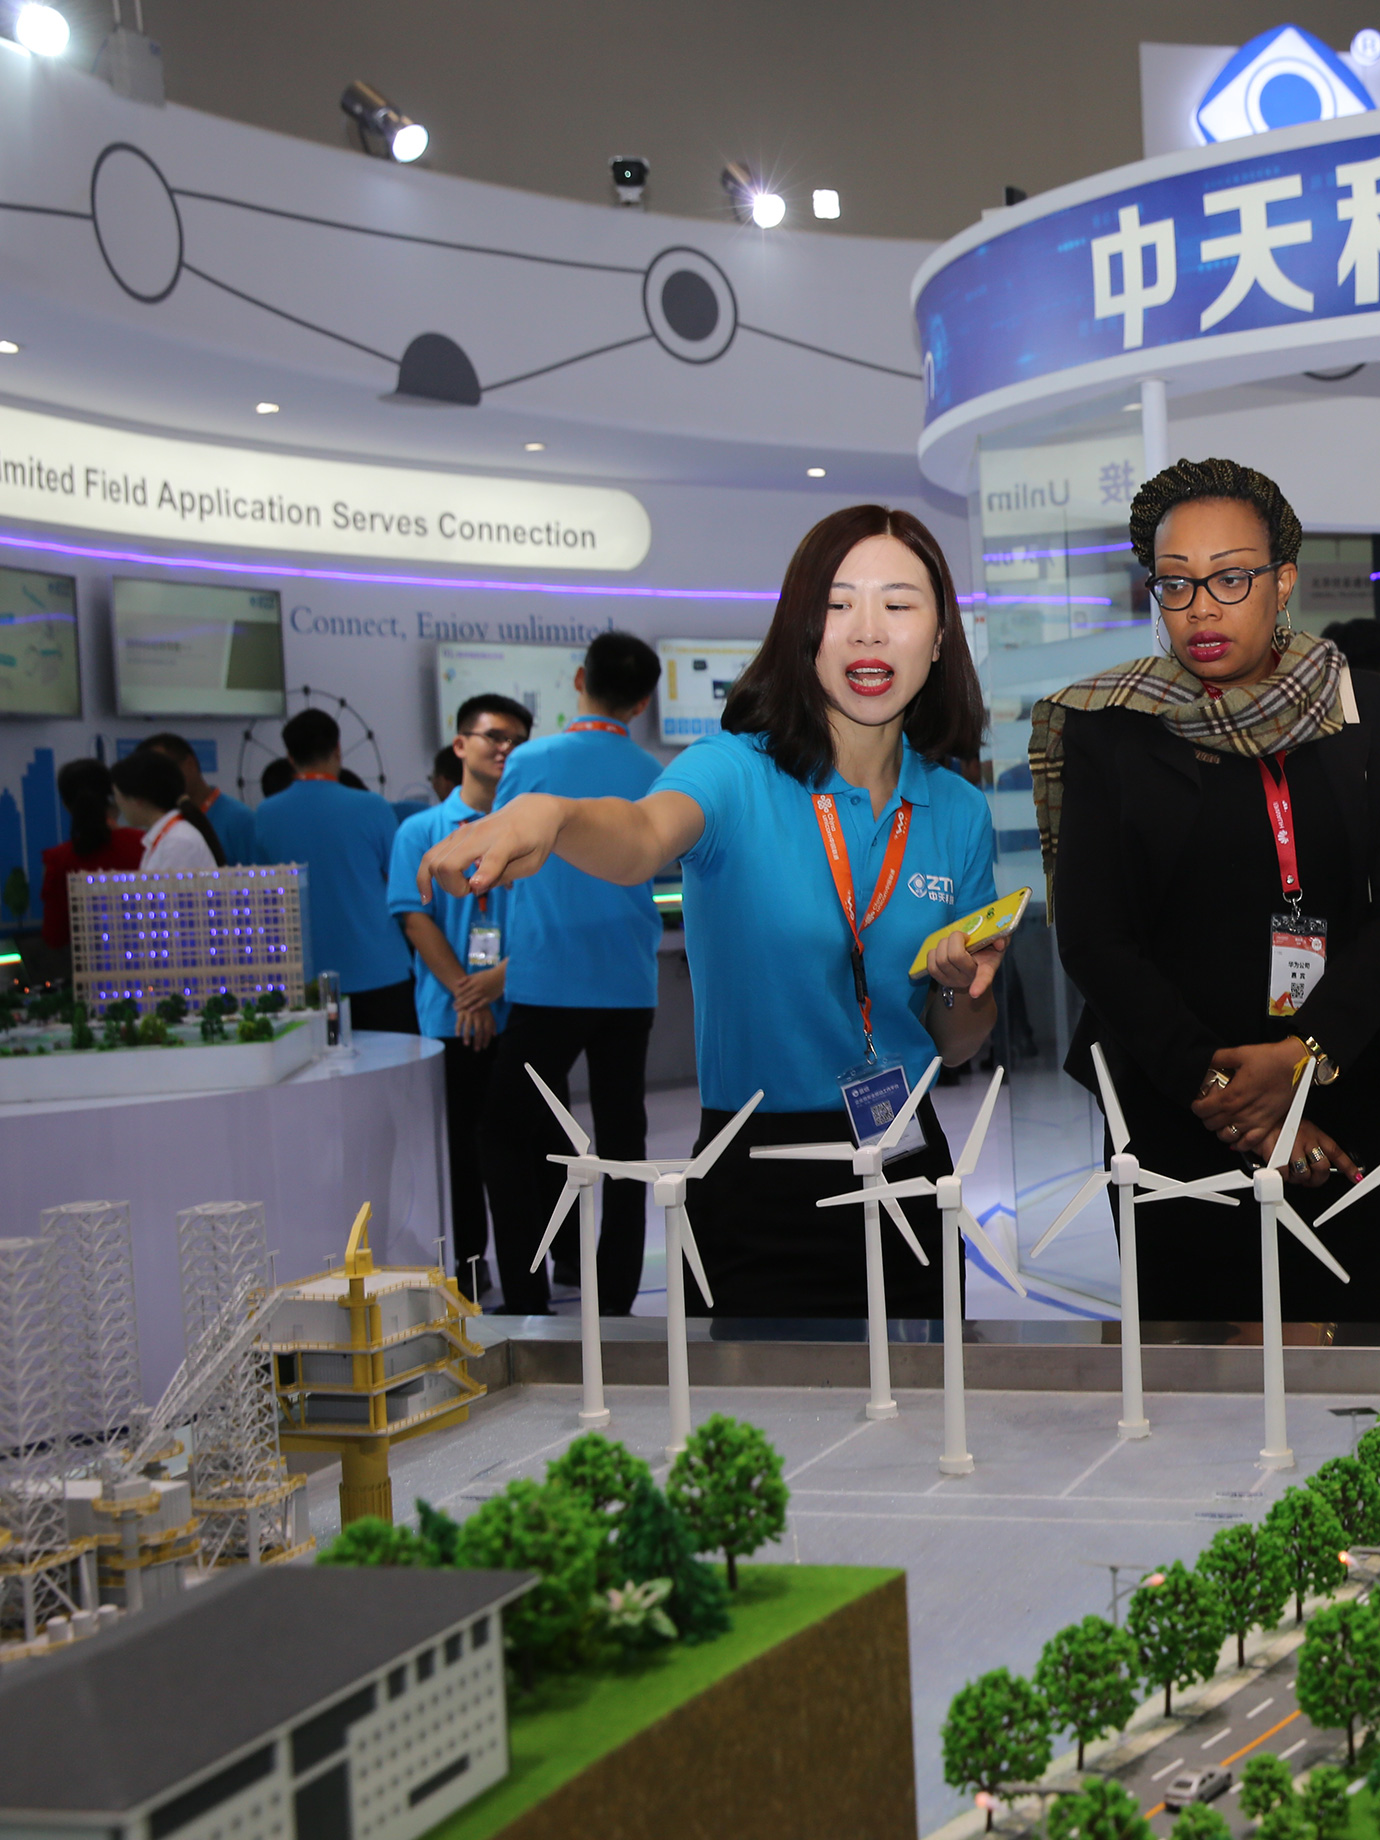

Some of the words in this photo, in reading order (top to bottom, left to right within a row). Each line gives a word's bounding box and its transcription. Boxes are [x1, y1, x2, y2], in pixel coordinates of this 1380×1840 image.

[0, 455, 75, 495] mited
[85, 467, 147, 506] Field
[158, 481, 321, 528] Application
[333, 501, 427, 537] Serves
[439, 512, 597, 549] Connection
[289, 604, 408, 641] Connect,
[928, 891, 955, 905] 中天科
